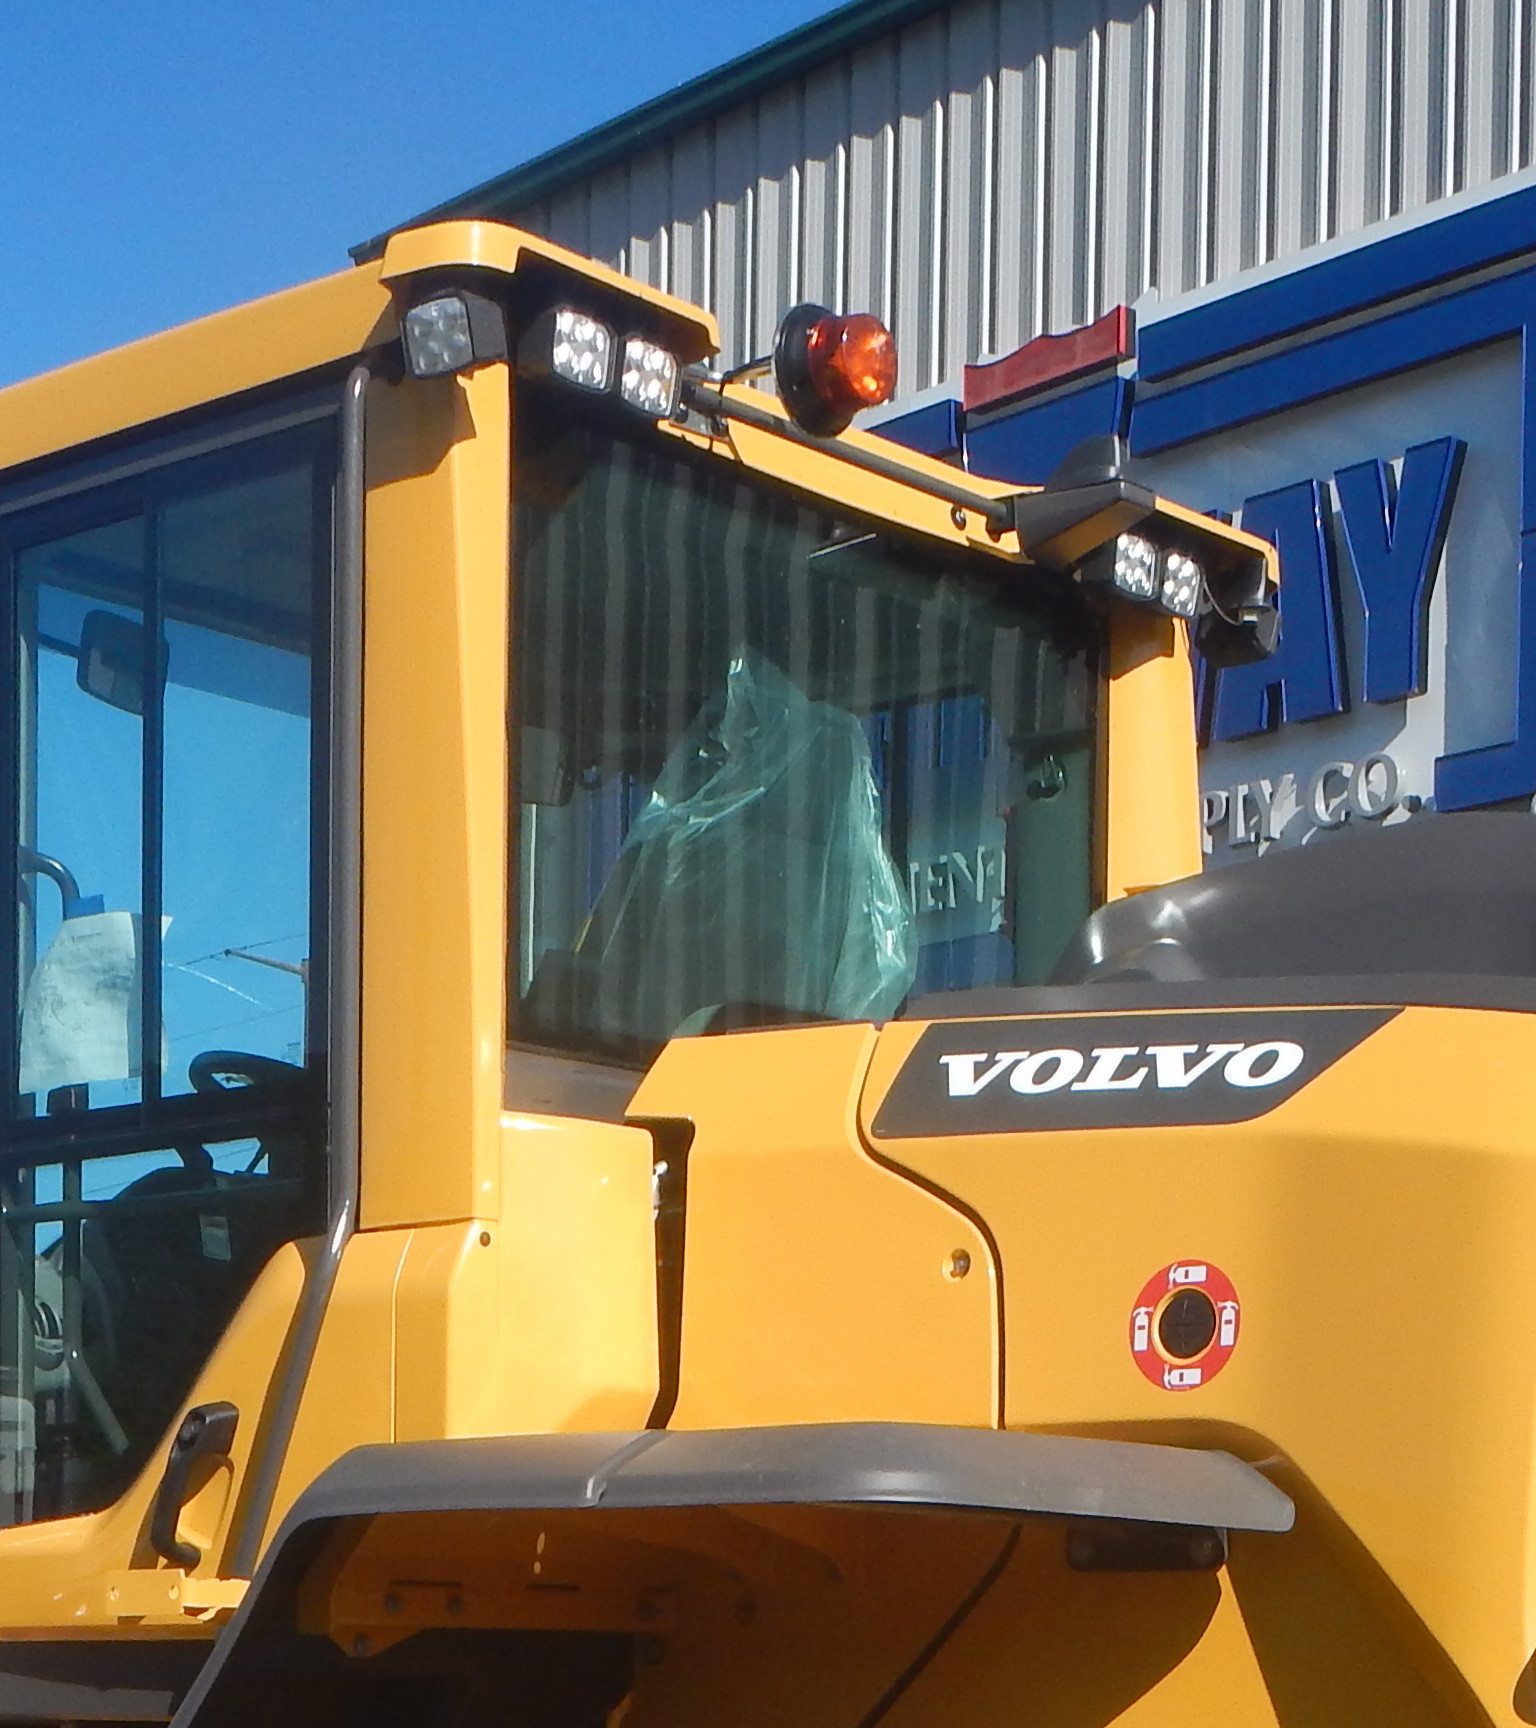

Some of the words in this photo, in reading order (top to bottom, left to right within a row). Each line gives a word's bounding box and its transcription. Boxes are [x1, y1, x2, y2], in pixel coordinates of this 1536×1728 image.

[1198, 436, 1468, 746] AY
[1306, 752, 1423, 830] CO.
[939, 1040, 1304, 1097] VOLVO
